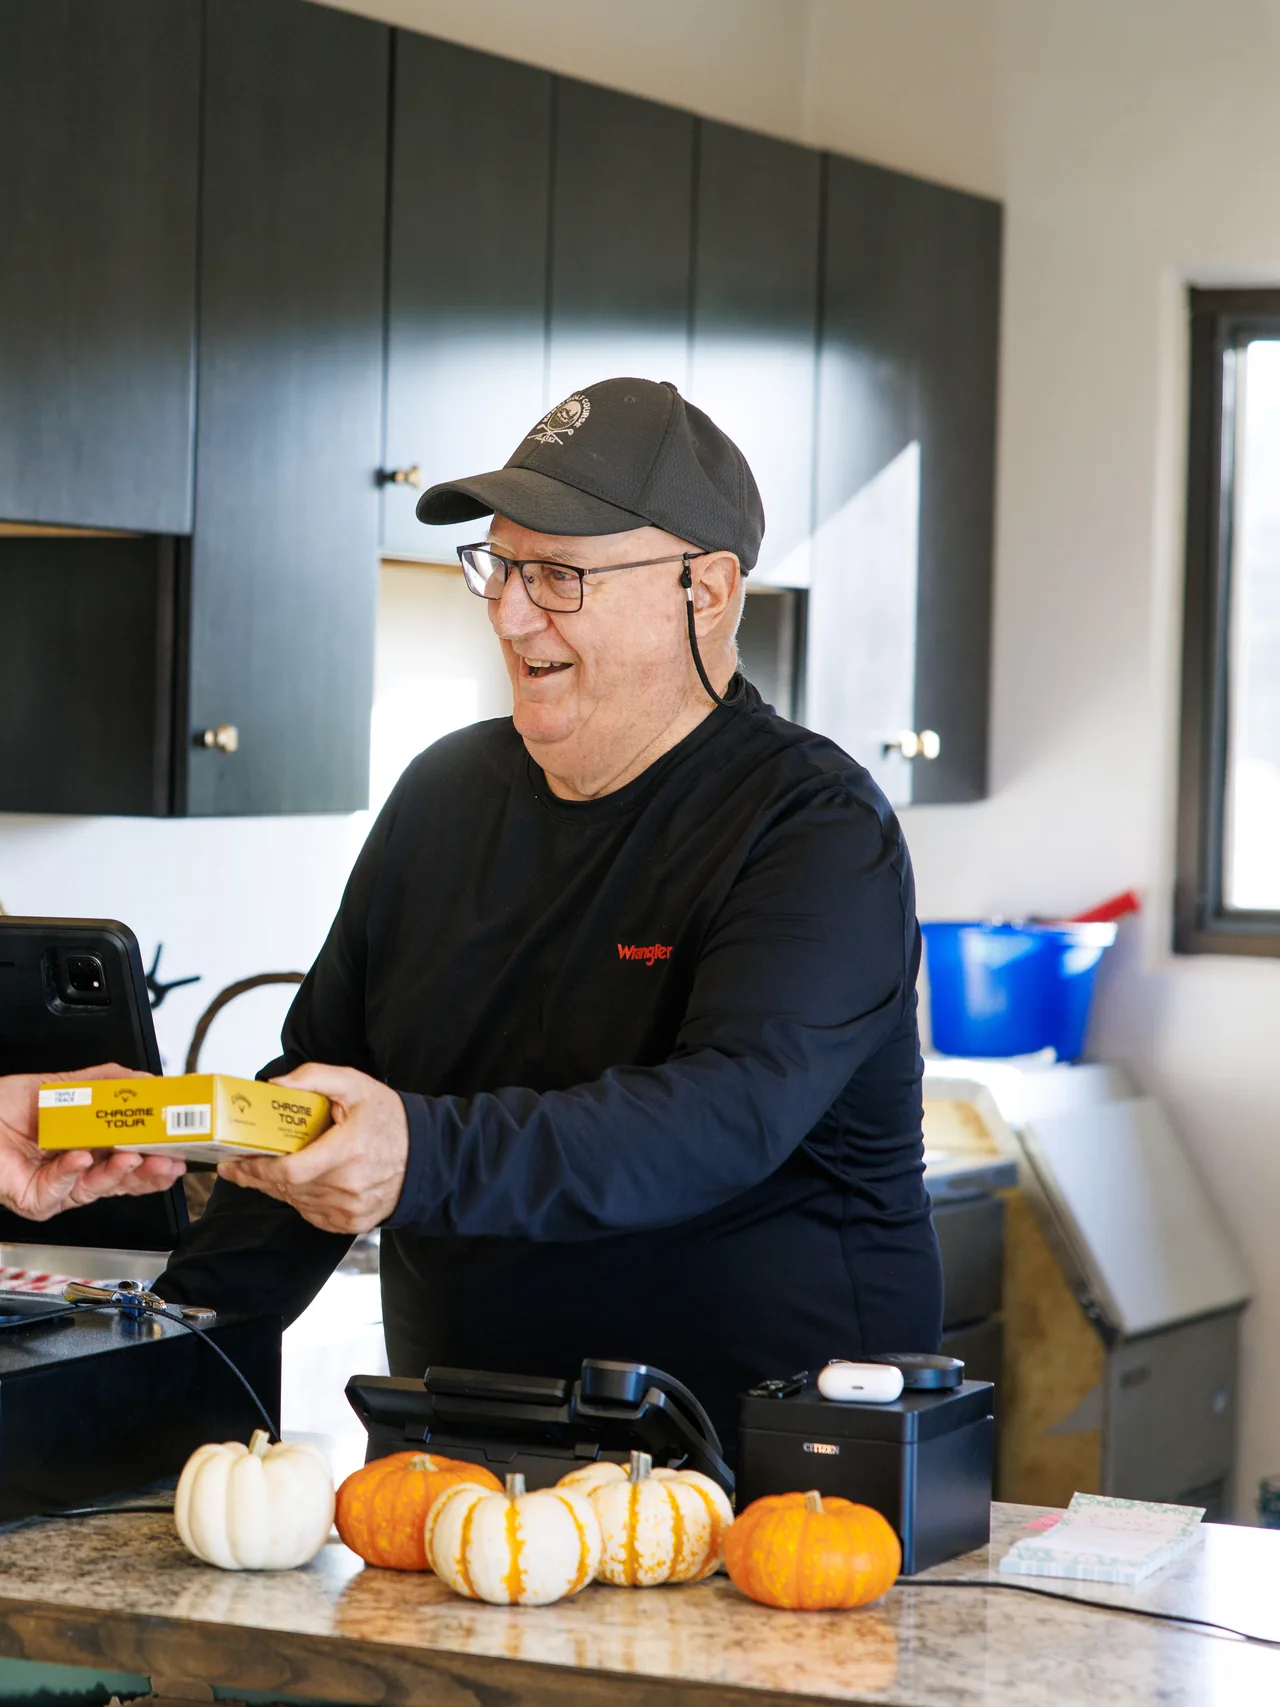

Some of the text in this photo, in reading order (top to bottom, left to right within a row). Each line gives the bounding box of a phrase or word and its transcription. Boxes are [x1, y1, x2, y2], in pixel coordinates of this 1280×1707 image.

[617, 943, 673, 966] Wrangler
[96, 1108, 154, 1118] CHROME
[271, 1100, 312, 1117] CHROME
[105, 1119, 145, 1128] TOUR
[278, 1113, 307, 1127] TOUR
[803, 1442, 840, 1455] CITIZEN
